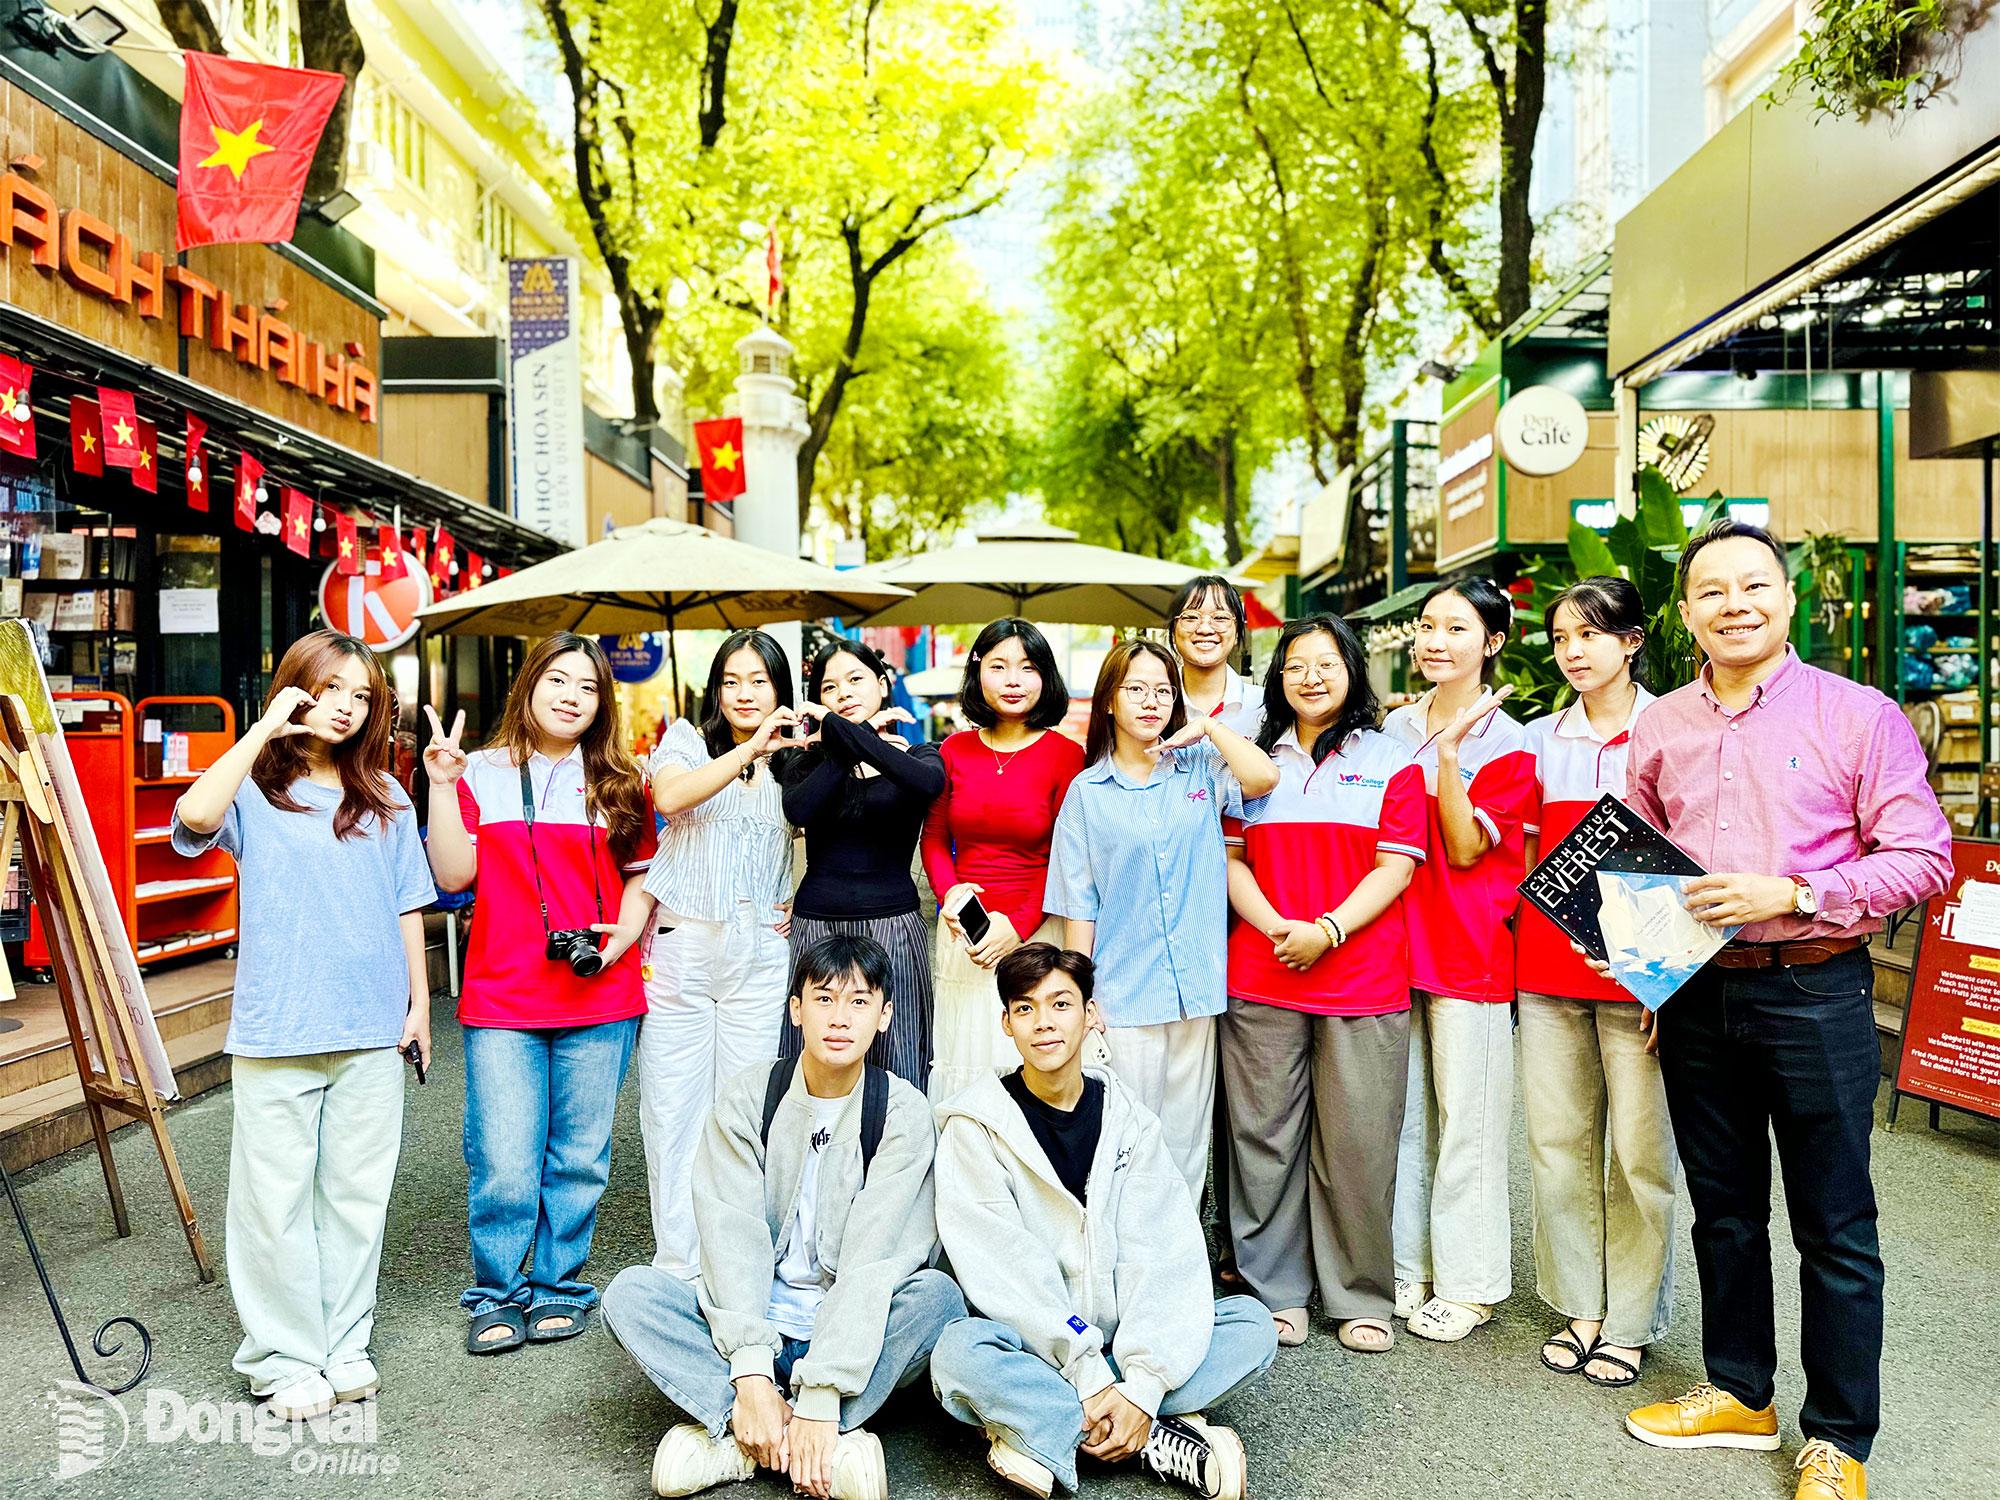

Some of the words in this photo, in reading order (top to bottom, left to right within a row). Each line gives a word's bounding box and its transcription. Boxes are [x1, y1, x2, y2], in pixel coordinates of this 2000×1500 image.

[0, 154, 164, 320] ÁCH
[164, 264, 306, 390] THÁI
[306, 341, 378, 424] HÀ
[532, 363, 549, 401] SEN
[534, 406, 550, 456] HOA
[1519, 424, 1573, 447] Café
[1361, 778, 1385, 786] College
[1529, 847, 1573, 891] CHINH
[1536, 811, 1630, 909] EVEREST
[1939, 978, 1957, 987] Peach
[1970, 984, 1992, 994] Lychee
[1941, 970, 1976, 983] Vietnamese
[1933, 984, 1951, 994] Fresh
[1951, 989, 1970, 998] fruits
[1941, 1032, 1971, 1045] Spaghetti
[1971, 1040, 1986, 1049] with
[1911, 1048, 1927, 1058] Fried
[1939, 1056, 1954, 1065] cake
[1959, 1061, 1979, 1071] bitter
[1979, 1067, 1999, 1077] gourd
[1971, 1072, 1987, 1082] than
